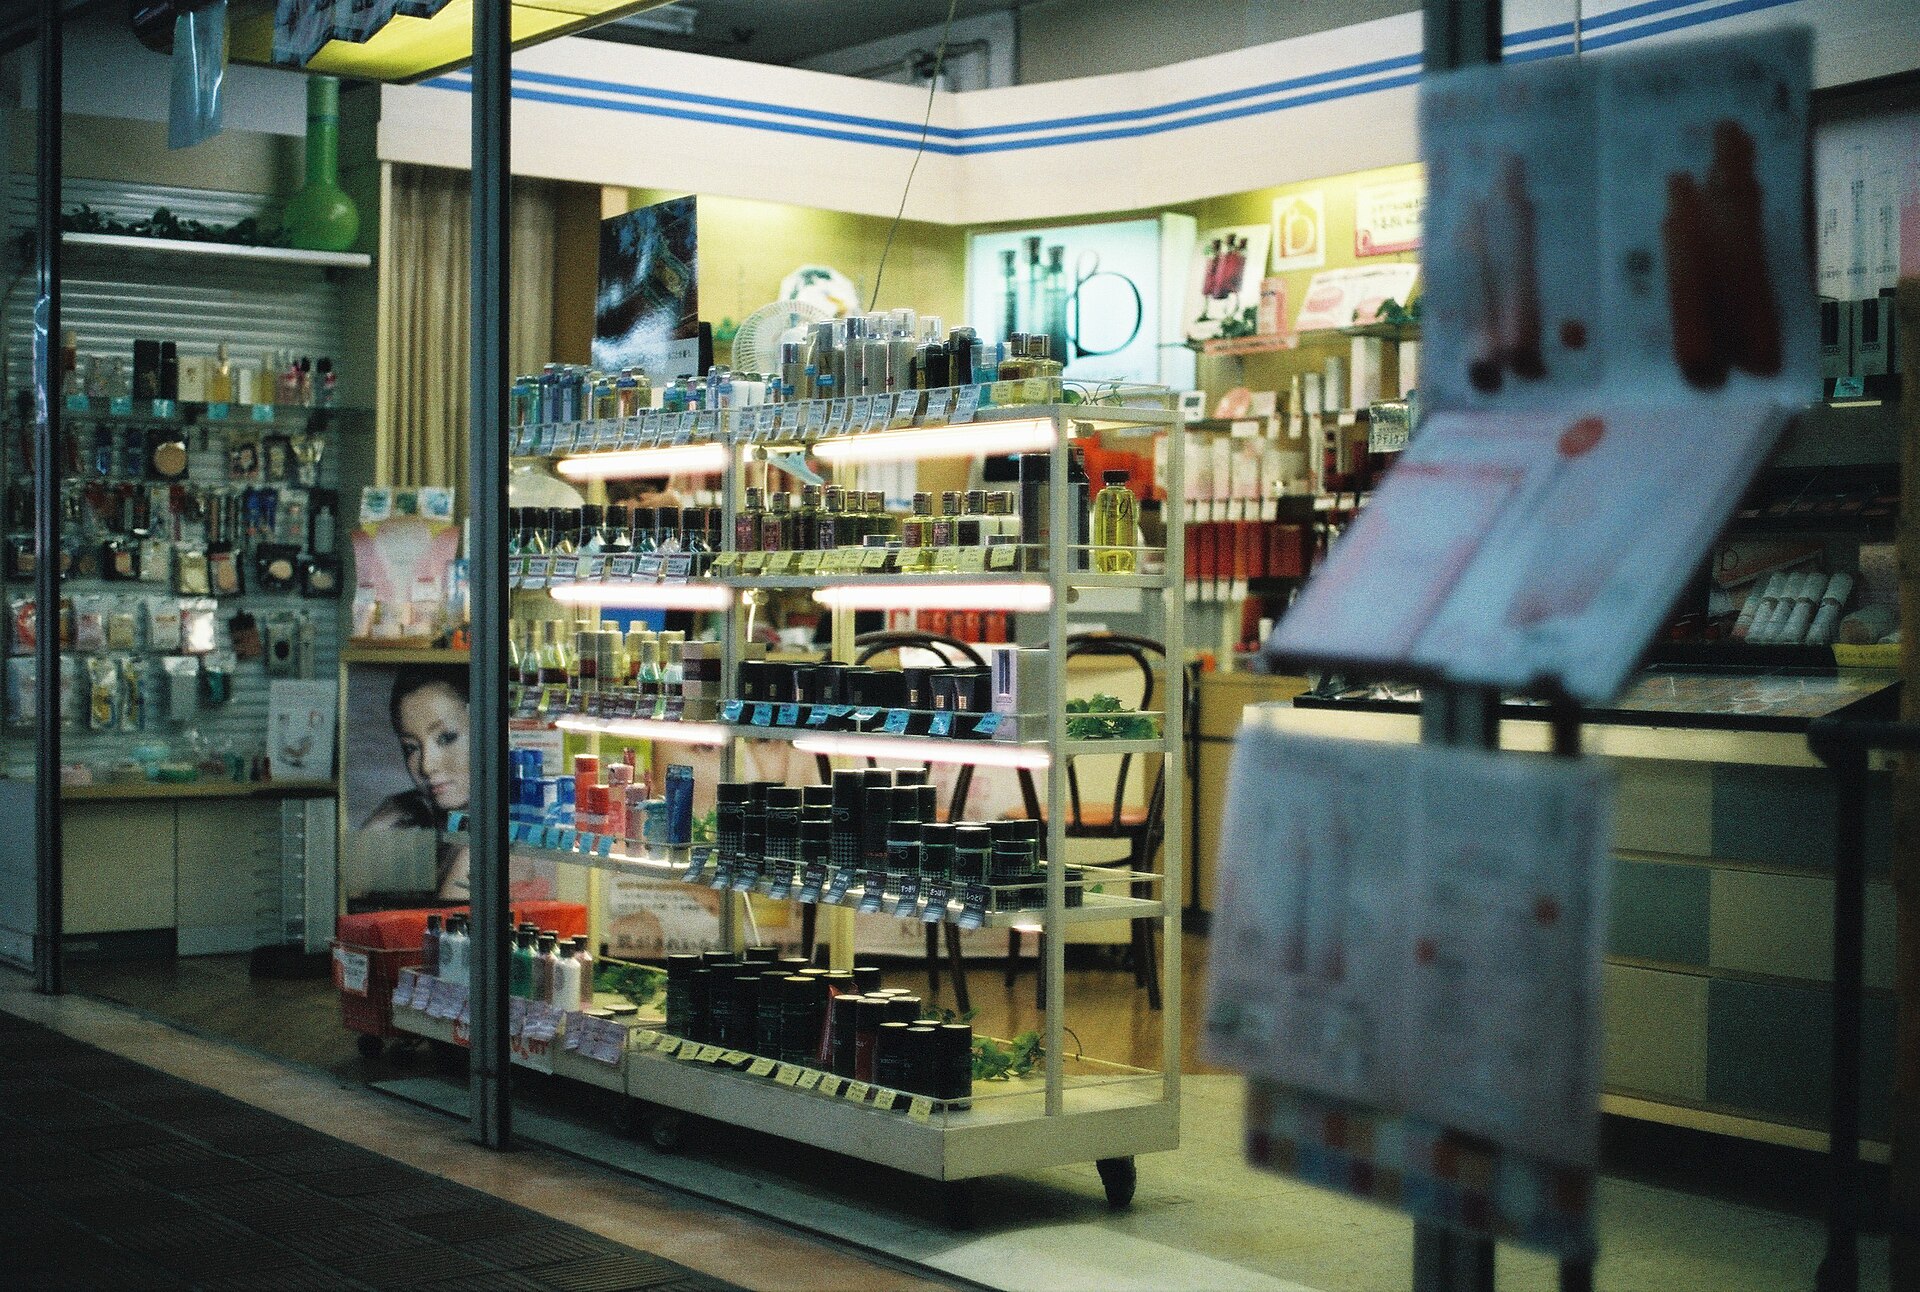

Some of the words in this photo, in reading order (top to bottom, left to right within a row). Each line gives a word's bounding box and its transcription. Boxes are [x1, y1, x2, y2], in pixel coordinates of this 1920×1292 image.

[1116, 495, 1132, 522] 9
[767, 810, 799, 825] MG5
[929, 887, 947, 898] さっぱり
[965, 891, 985, 904] しっとり
